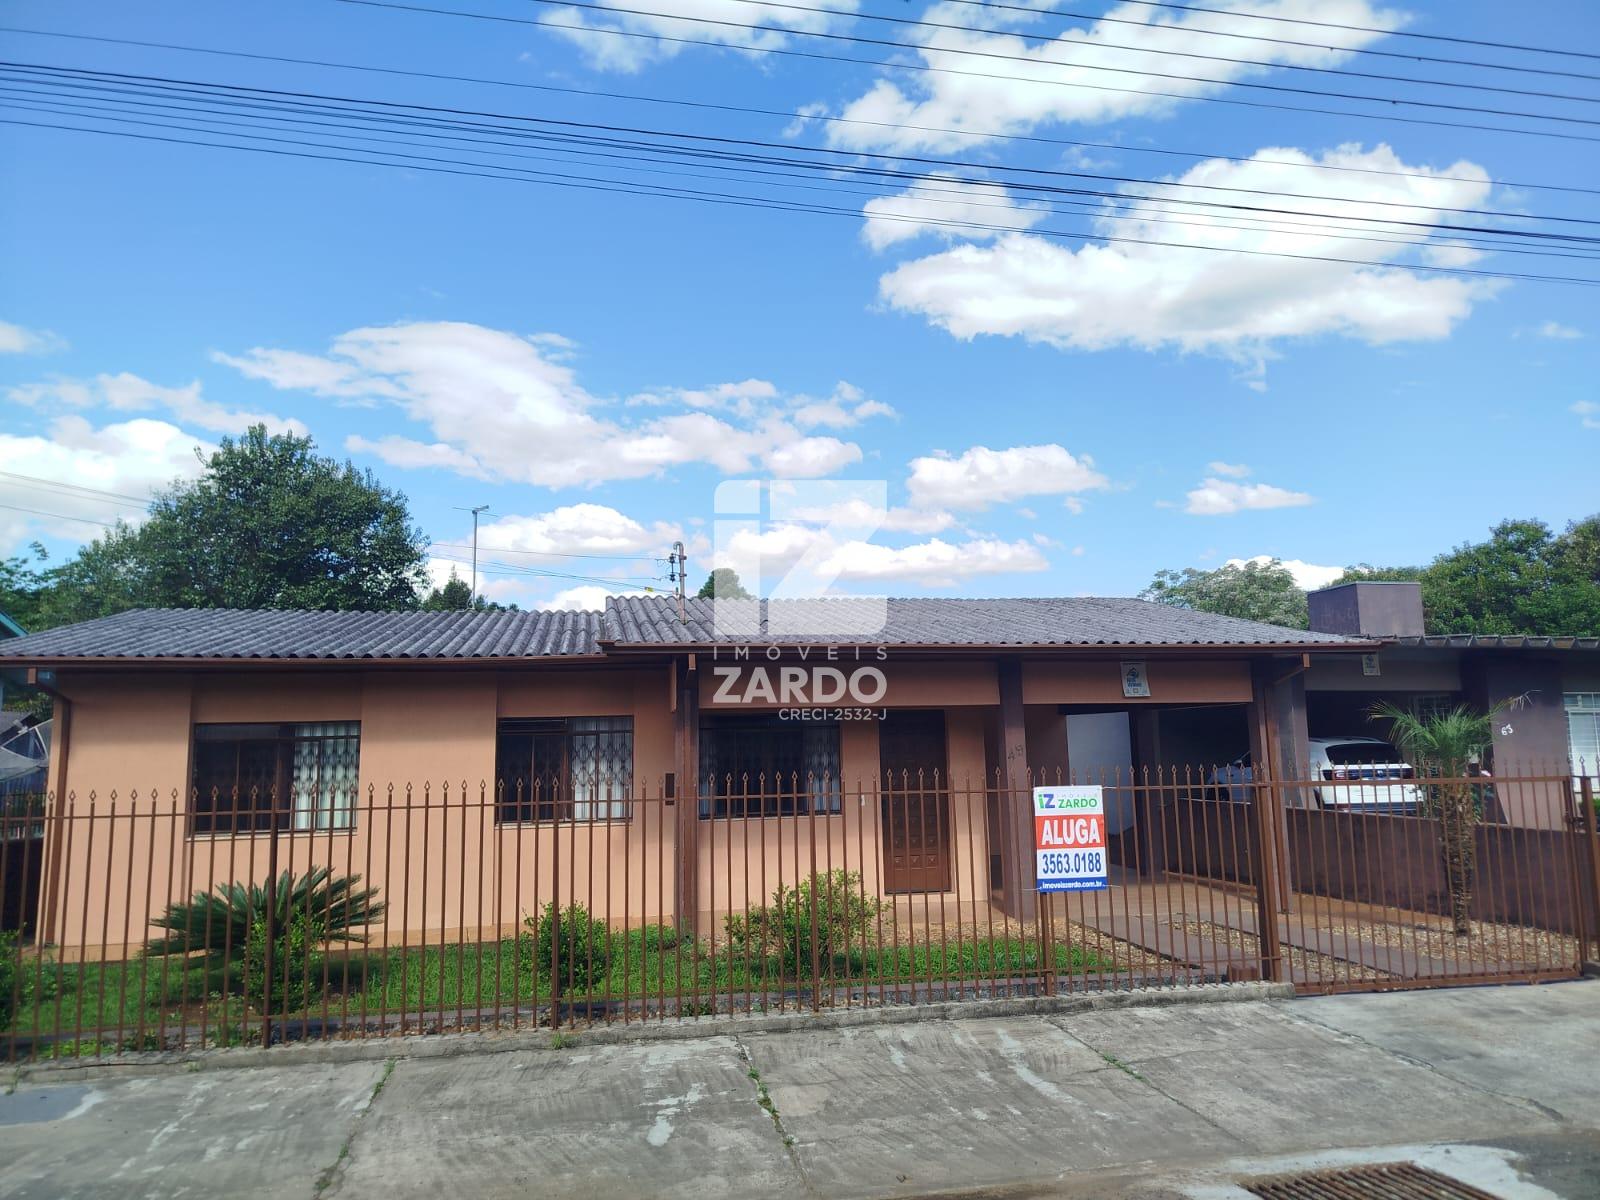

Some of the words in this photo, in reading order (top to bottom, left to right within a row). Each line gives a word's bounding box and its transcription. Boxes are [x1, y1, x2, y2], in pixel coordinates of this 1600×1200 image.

[1058, 798, 1098, 809] ZARDO
[1041, 818, 1101, 846] ALUGA
[1042, 852, 1102, 874] 3563.0188
